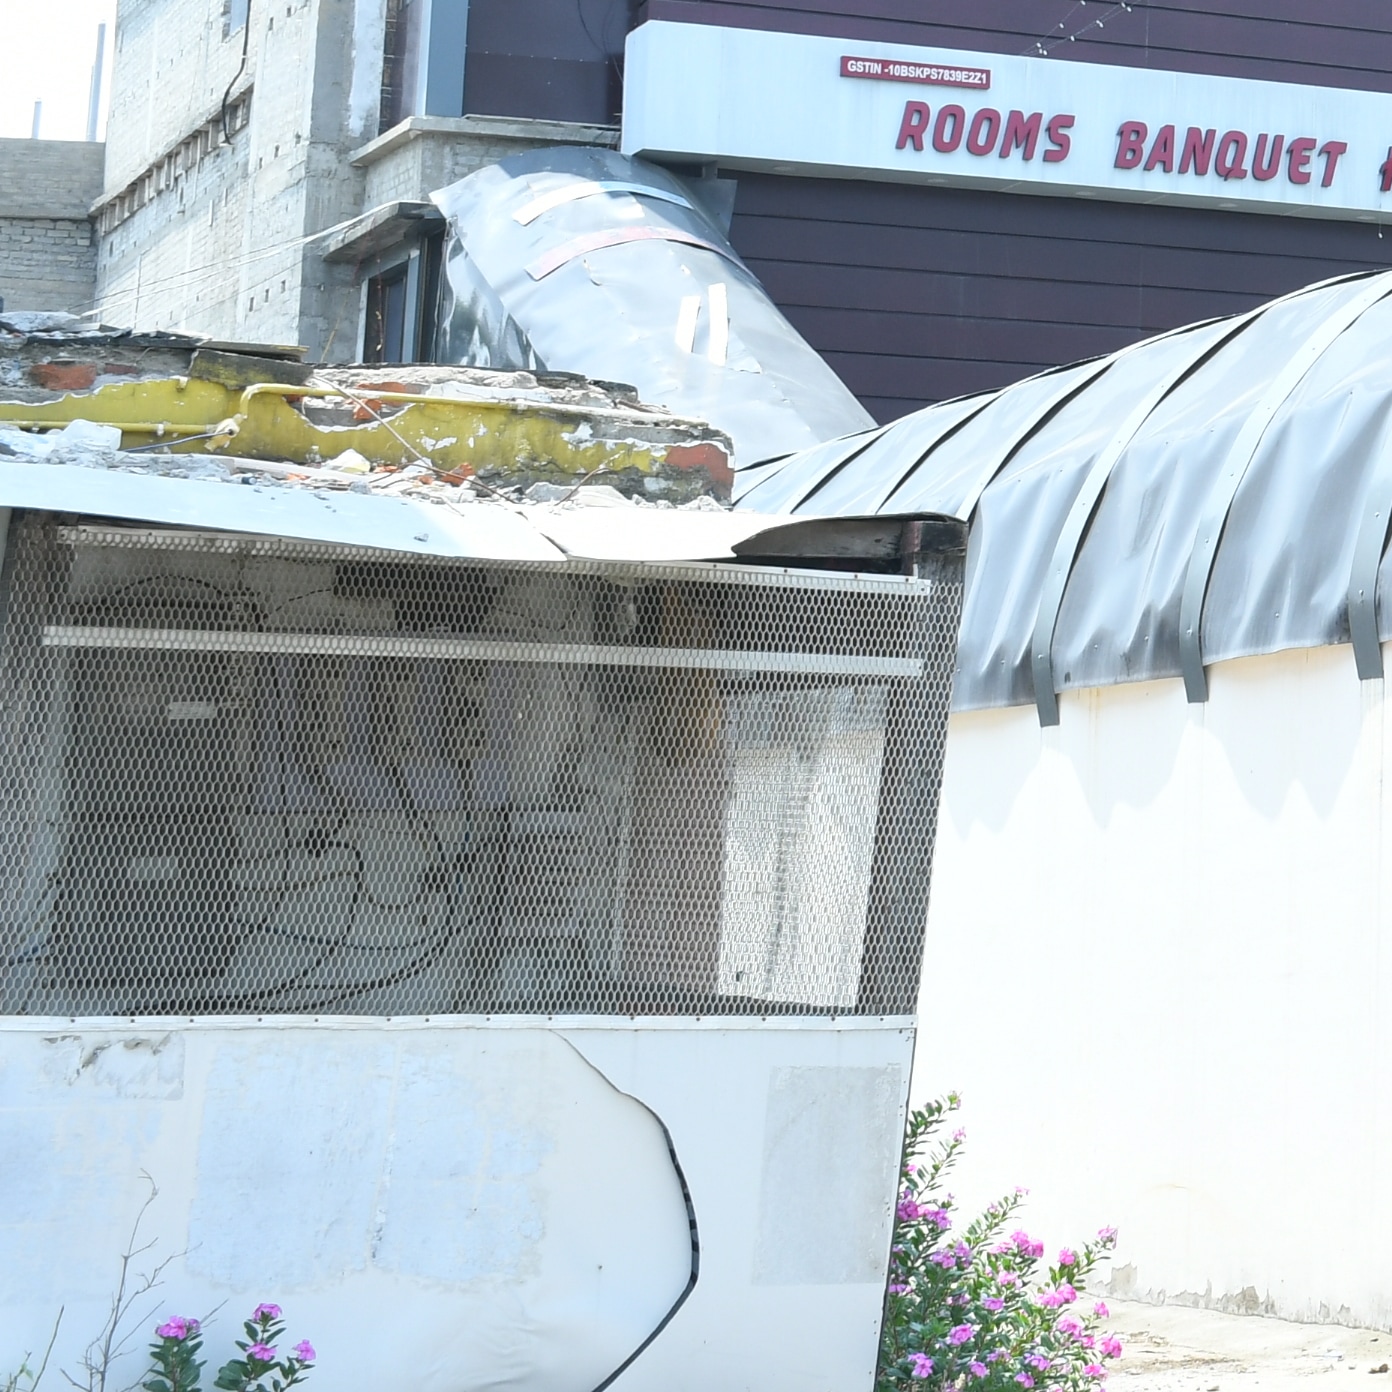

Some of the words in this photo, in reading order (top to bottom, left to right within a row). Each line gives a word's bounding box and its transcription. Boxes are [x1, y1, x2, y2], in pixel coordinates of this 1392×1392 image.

[847, 60, 882, 74] GSTIN
[896, 99, 1076, 163] ROOMS
[1114, 119, 1348, 187] BANQUET
